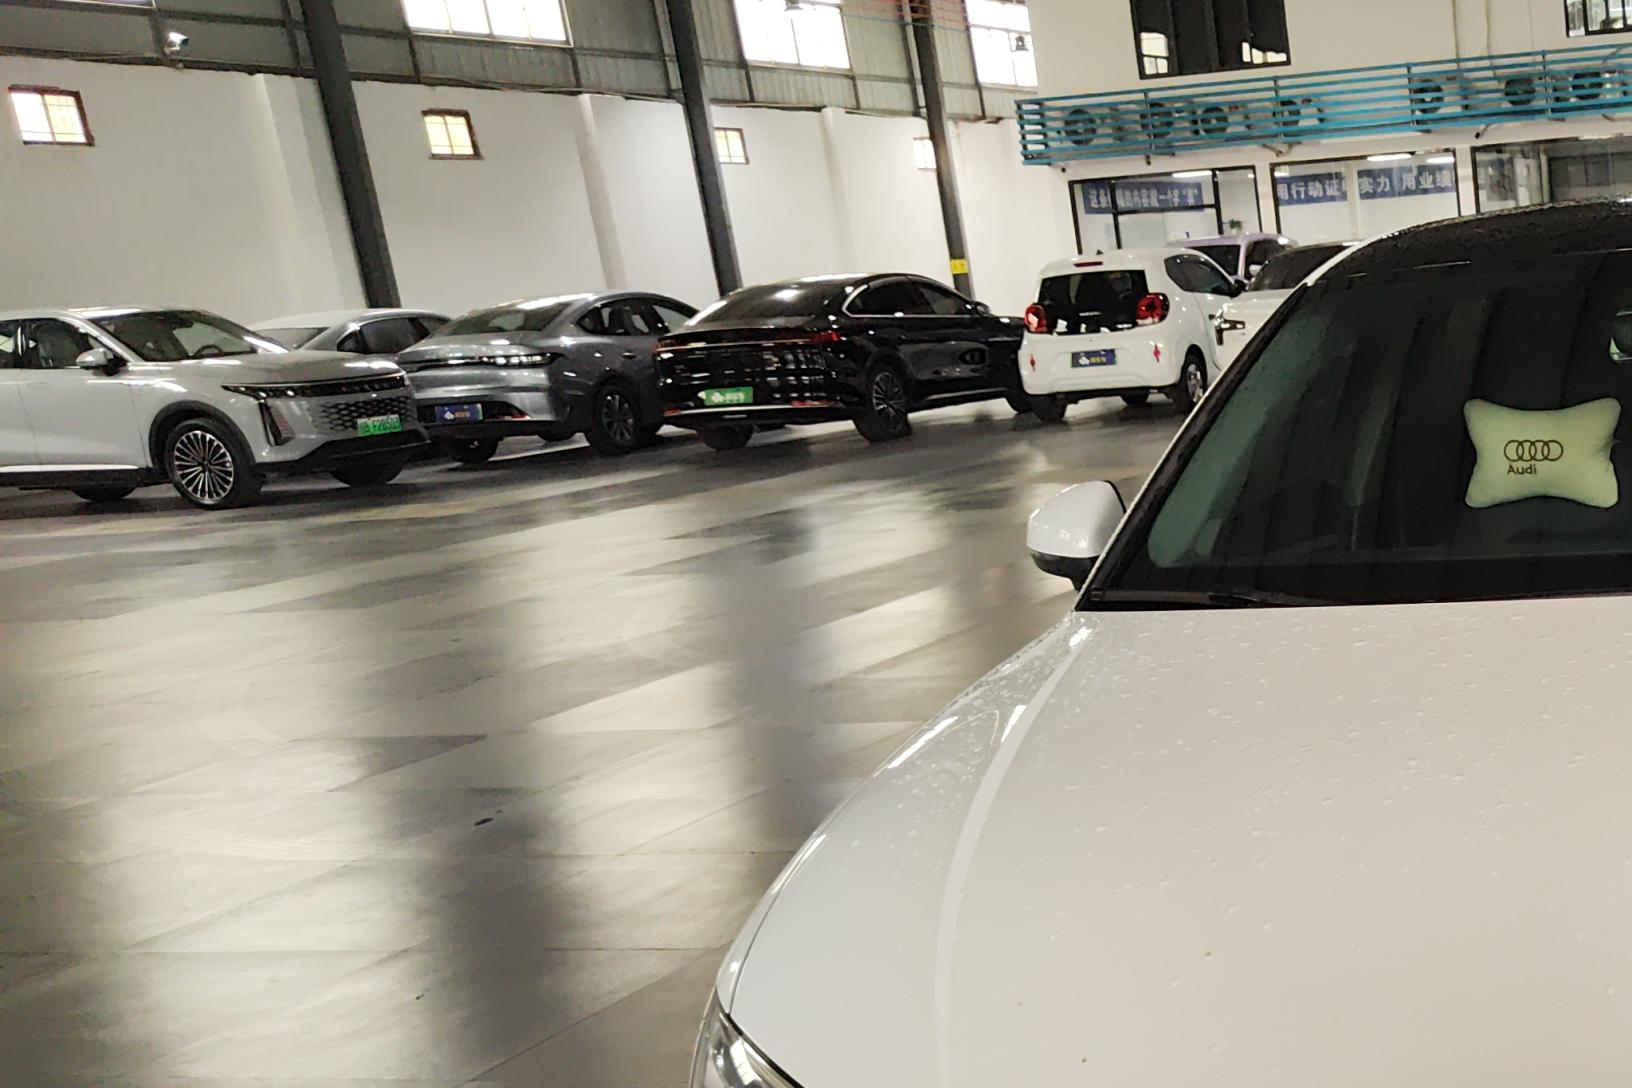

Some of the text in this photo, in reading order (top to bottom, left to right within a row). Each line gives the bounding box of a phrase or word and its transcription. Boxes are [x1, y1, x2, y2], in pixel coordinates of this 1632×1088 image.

[1402, 169, 1455, 190] 用业绩
[1507, 463, 1537, 475] Audi
